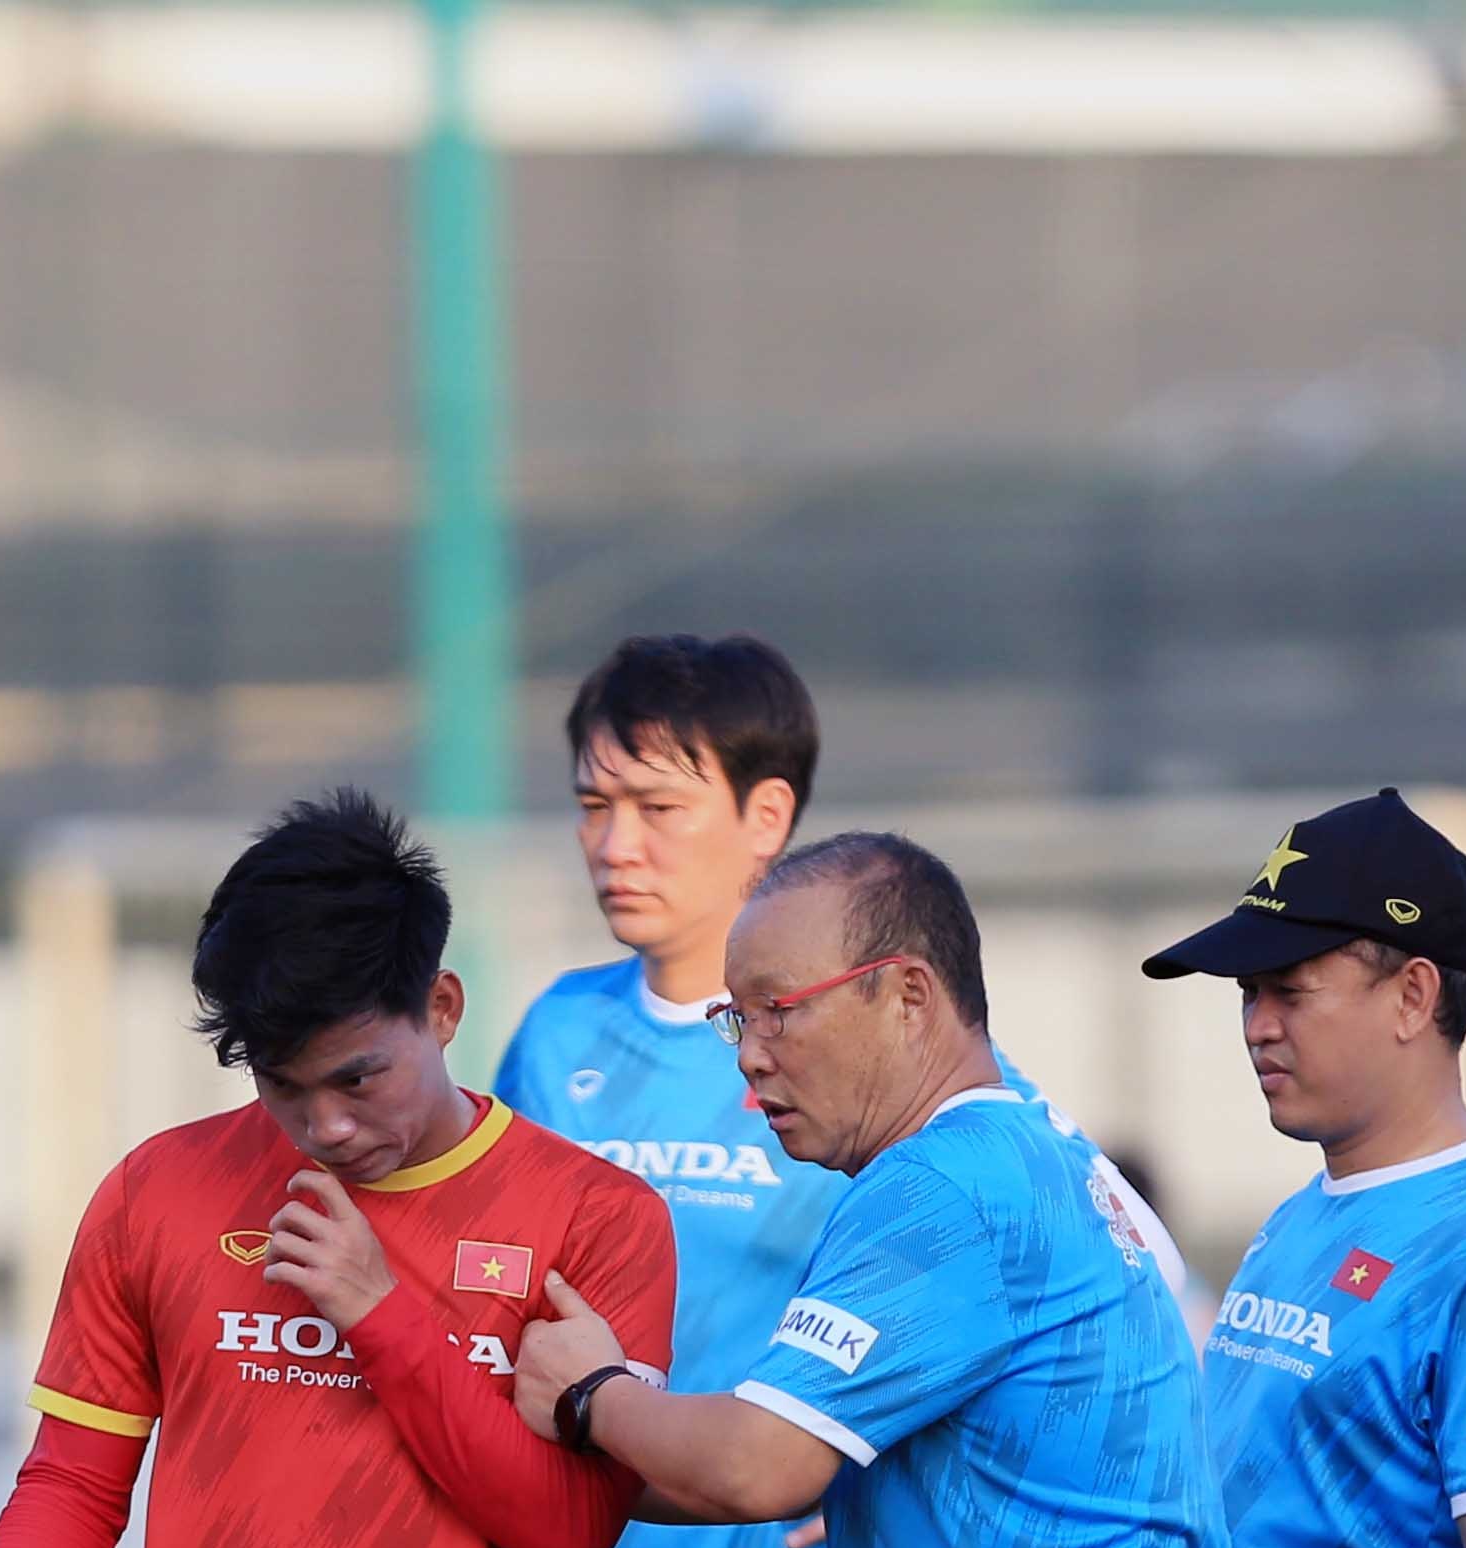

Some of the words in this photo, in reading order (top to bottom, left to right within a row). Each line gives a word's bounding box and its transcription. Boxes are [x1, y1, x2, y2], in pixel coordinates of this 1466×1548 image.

[577, 1140, 782, 1185] ONDA
[676, 1185, 755, 1209] Dreams
[238, 1362, 280, 1382] The
[286, 1365, 362, 1389] Power
